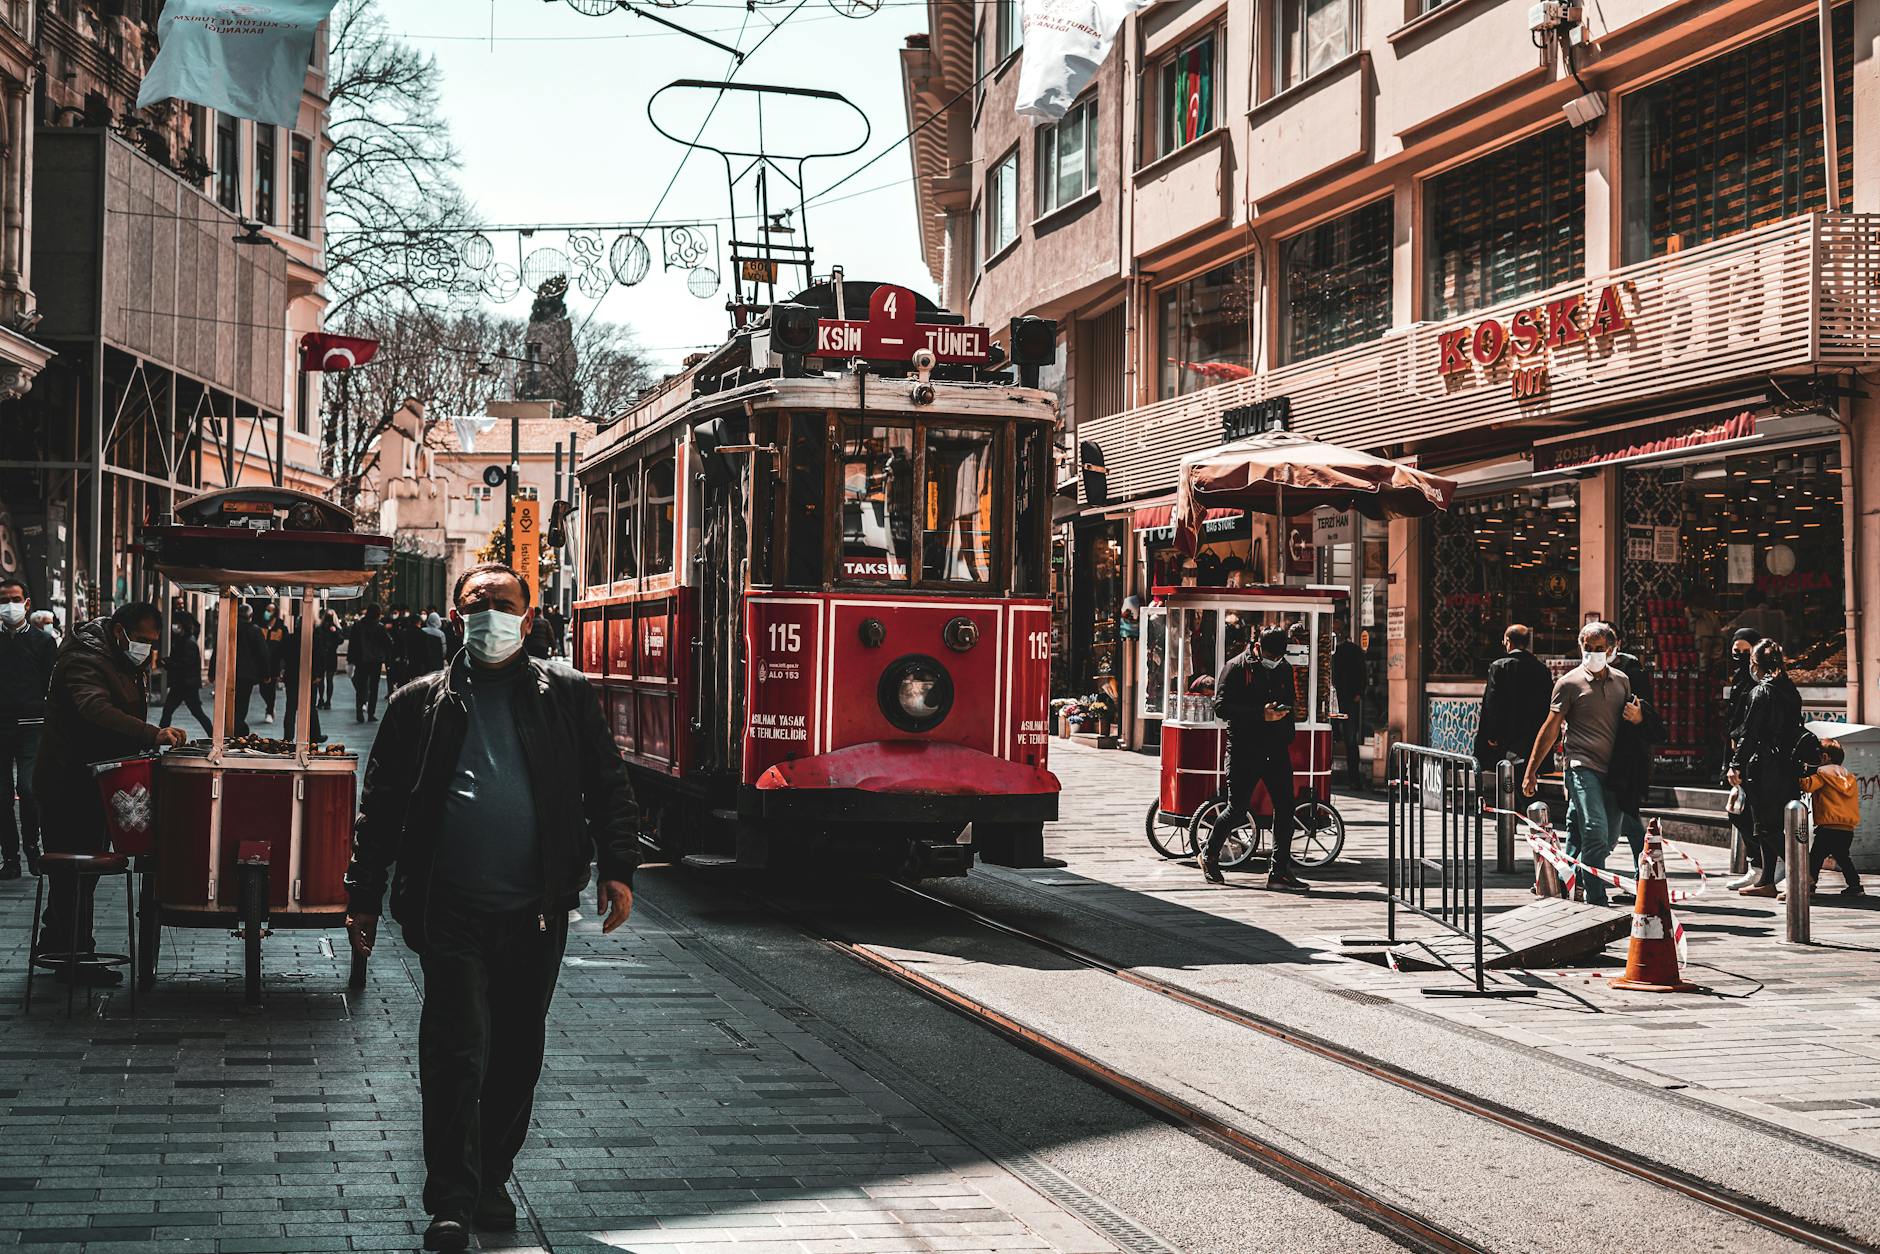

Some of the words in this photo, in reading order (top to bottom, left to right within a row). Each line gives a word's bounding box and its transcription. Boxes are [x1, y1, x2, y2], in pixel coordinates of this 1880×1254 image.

[1066, 20, 1102, 39] TURİZM
[883, 291, 897, 320] 4
[1438, 283, 1635, 376] KOSKA
[817, 323, 862, 352] KSİM
[925, 327, 987, 357] TÜNEL
[1510, 366, 1548, 400] 1907
[1555, 445, 1597, 462] KOSKA
[1205, 522, 1218, 533] BAG
[1335, 513, 1349, 529] HAN
[843, 562, 907, 575] TAKSİM
[768, 623, 801, 653] 115
[1028, 631, 1049, 660] 115
[768, 671, 783, 679] ALO
[785, 671, 800, 680] 153
[751, 713, 776, 726] ASILMAK
[779, 715, 805, 727] YASAK
[757, 727, 807, 741] TEHLİKELİDİR
[1017, 733, 1027, 745] VE
[1422, 759, 1442, 794] POLİS
